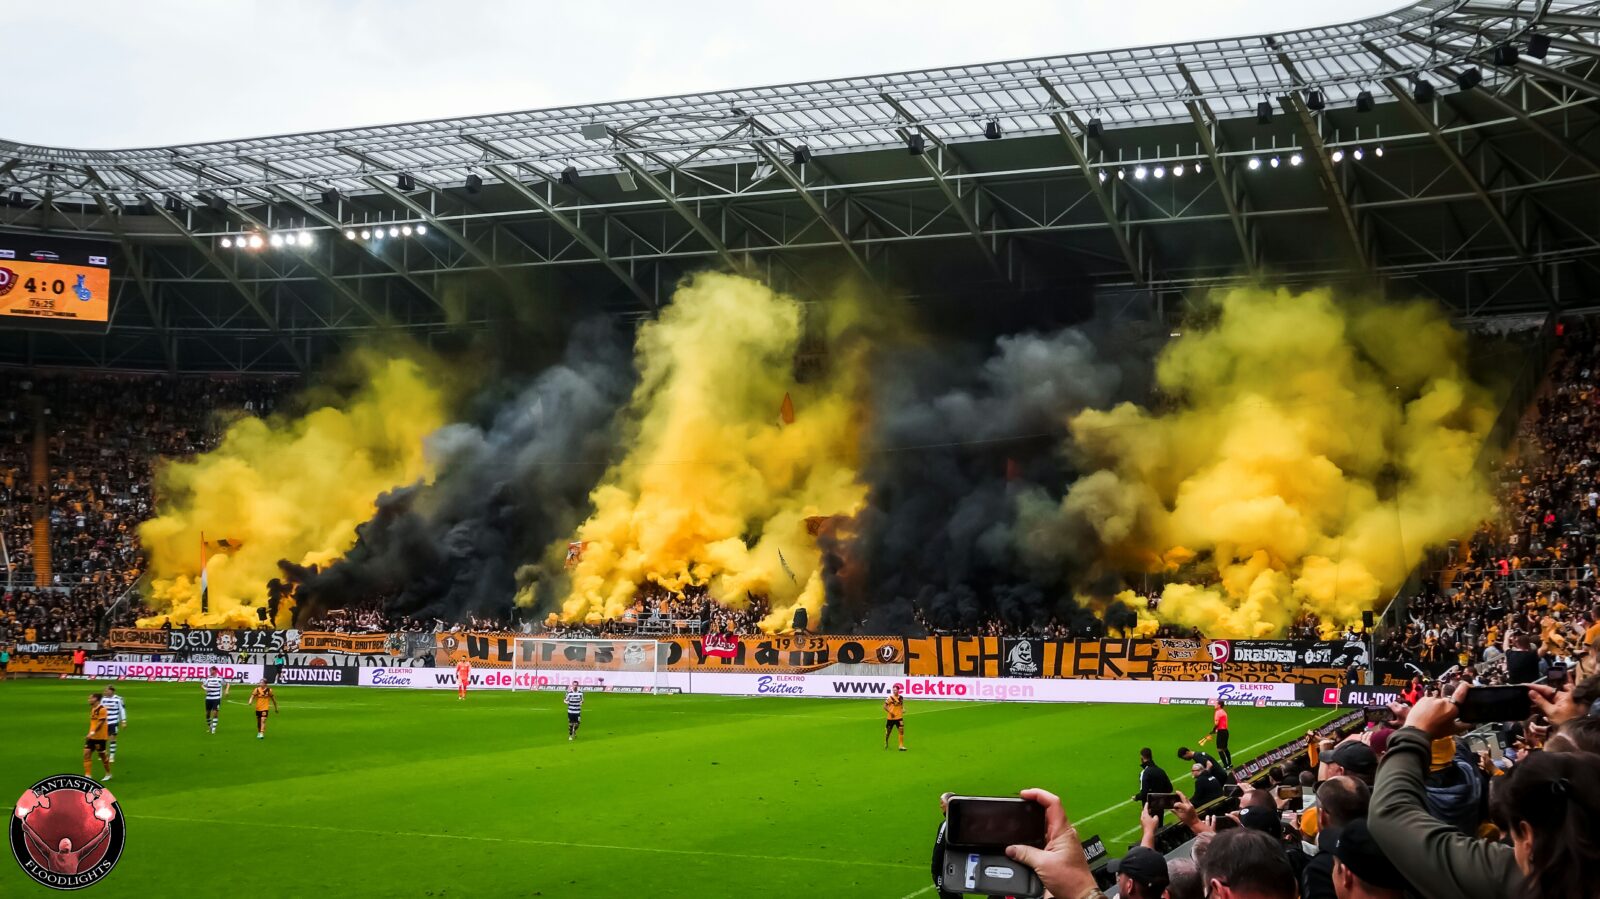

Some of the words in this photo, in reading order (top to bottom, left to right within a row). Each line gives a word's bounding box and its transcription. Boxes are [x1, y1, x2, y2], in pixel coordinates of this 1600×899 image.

[281, 669, 342, 682] RUNNING
[372, 668, 412, 685] Büttner
[758, 675, 805, 694] Büttner
